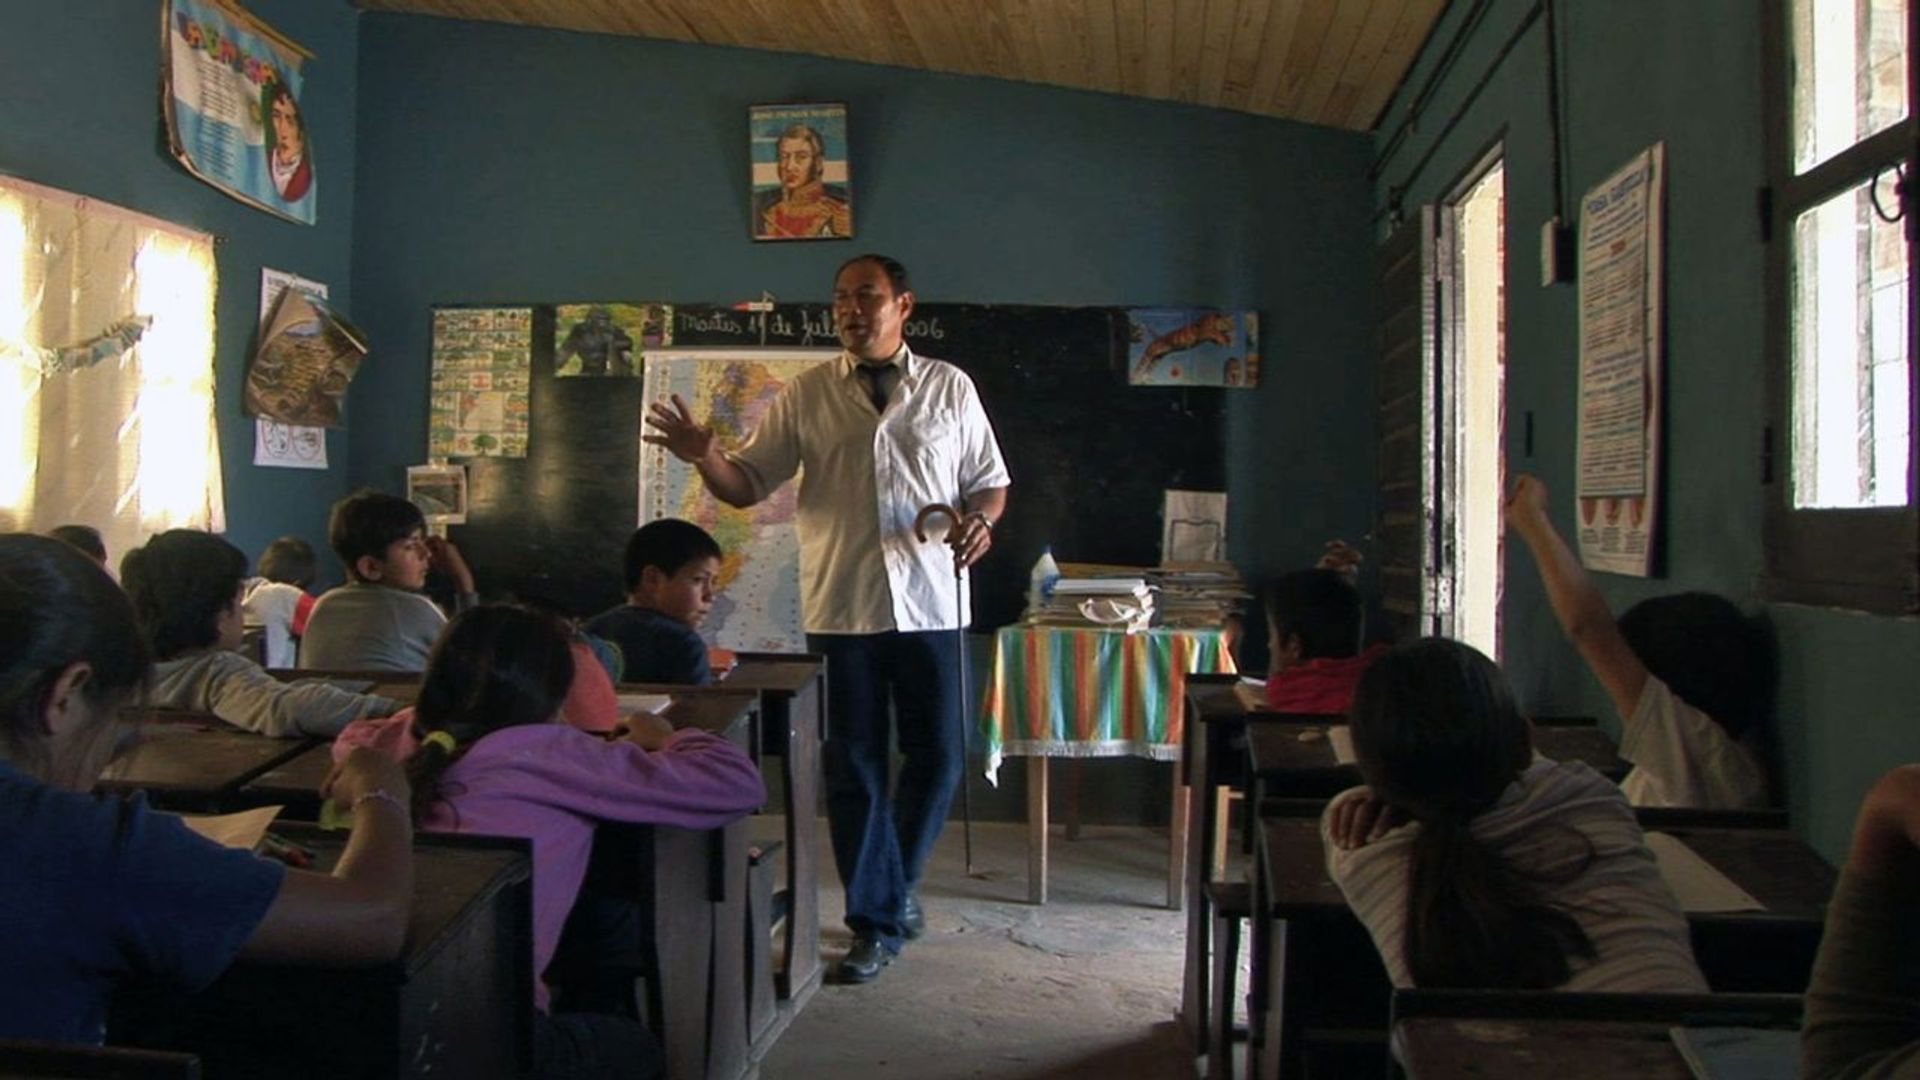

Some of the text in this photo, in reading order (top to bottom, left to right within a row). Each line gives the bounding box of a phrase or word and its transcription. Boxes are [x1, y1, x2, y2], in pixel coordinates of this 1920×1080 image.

[681, 311, 743, 335] Martes
[771, 313, 795, 337] de
[801, 309, 839, 346] Juli
[904, 317, 945, 339] 006
